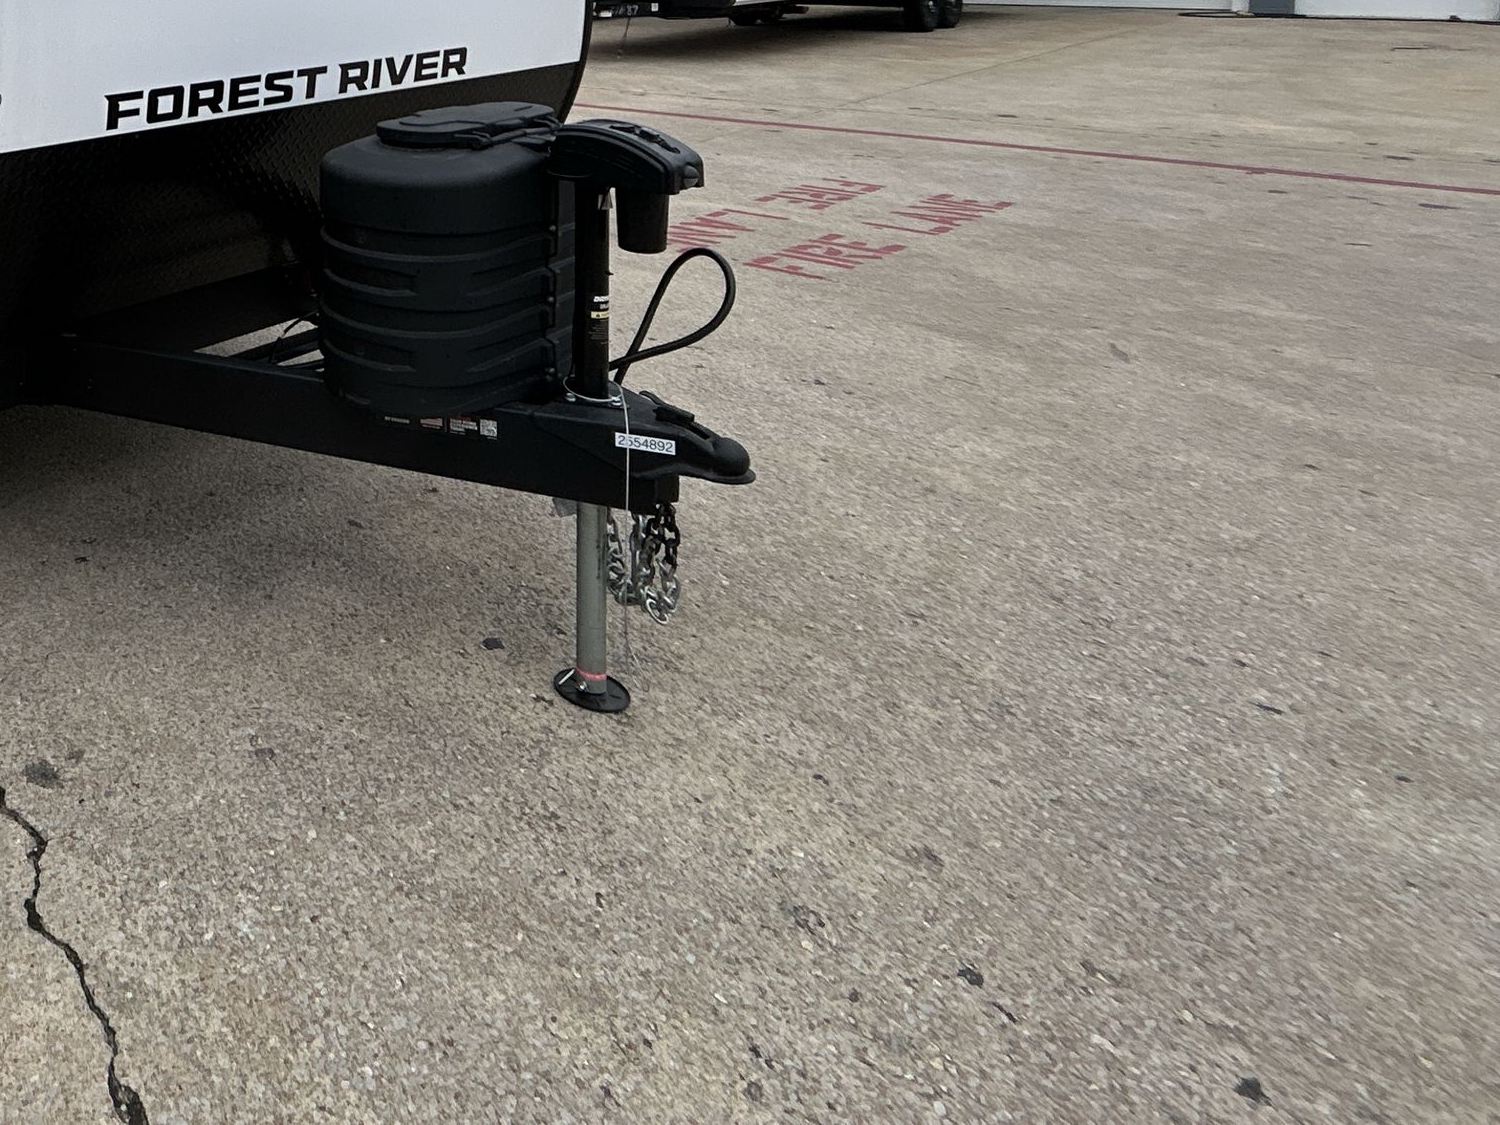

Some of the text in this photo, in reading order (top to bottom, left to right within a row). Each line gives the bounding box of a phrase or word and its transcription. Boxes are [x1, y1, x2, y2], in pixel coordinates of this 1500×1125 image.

[103, 46, 468, 131] FOREST RIVER
[742, 193, 1016, 280] FIRE LANE
[617, 435, 674, 453] 2554892
